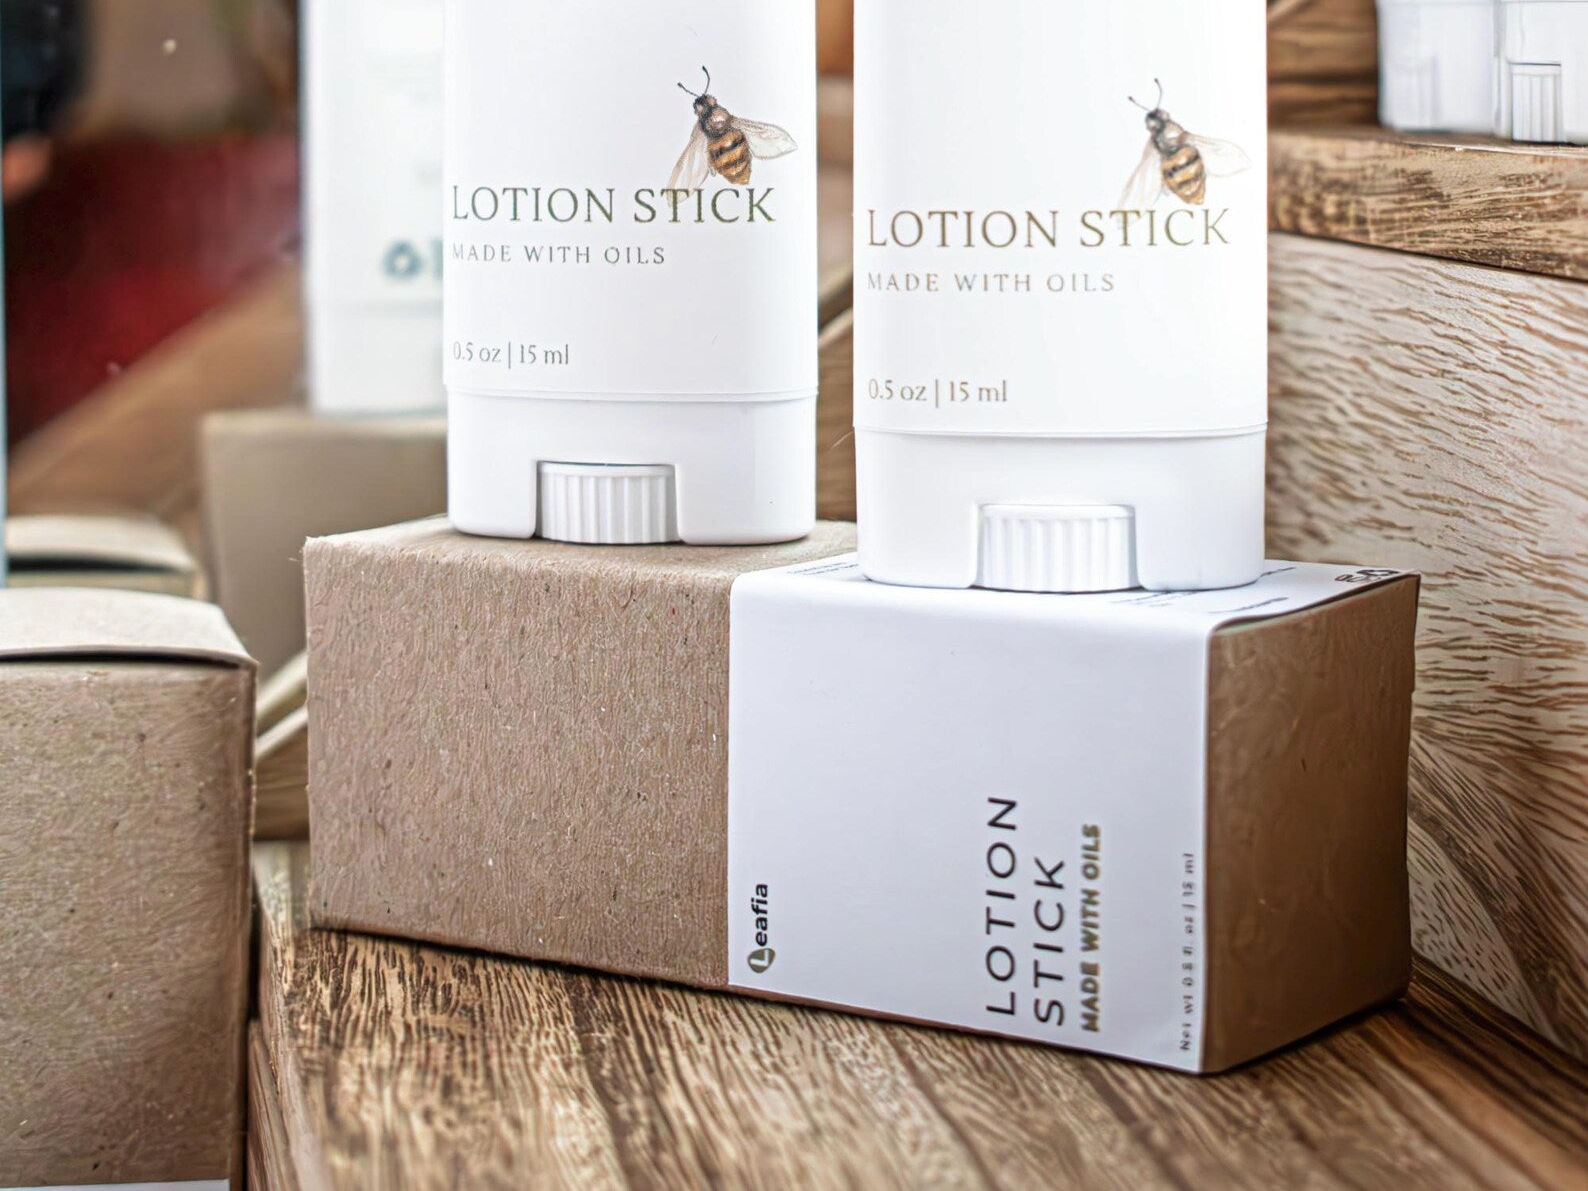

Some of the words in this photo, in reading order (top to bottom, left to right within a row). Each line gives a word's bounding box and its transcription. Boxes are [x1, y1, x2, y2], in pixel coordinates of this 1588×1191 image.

[452, 184, 616, 224] LOTION
[633, 186, 776, 224] STICK
[866, 208, 1059, 249] LOTION
[1079, 208, 1231, 248] STICK
[452, 243, 512, 264] MADE
[524, 245, 591, 265] WITH
[603, 245, 666, 266] OILS
[867, 271, 940, 293] MADE
[953, 272, 1032, 293] WITH
[1045, 272, 1116, 293] OILS
[453, 340, 475, 362] 0.5
[478, 346, 502, 364] oz
[518, 343, 538, 366] 15
[543, 342, 570, 367] ml
[867, 377, 894, 401] 0.5
[899, 384, 928, 403] oz
[948, 379, 971, 403] 15
[977, 378, 1009, 403] ml
[1080, 823, 1102, 882] OILS
[748, 883, 771, 971] Leafia
[984, 796, 1018, 1018] LOTION
[1079, 887, 1101, 953] WITH
[1033, 856, 1066, 1027] STICK
[1078, 961, 1101, 1034] MADE
